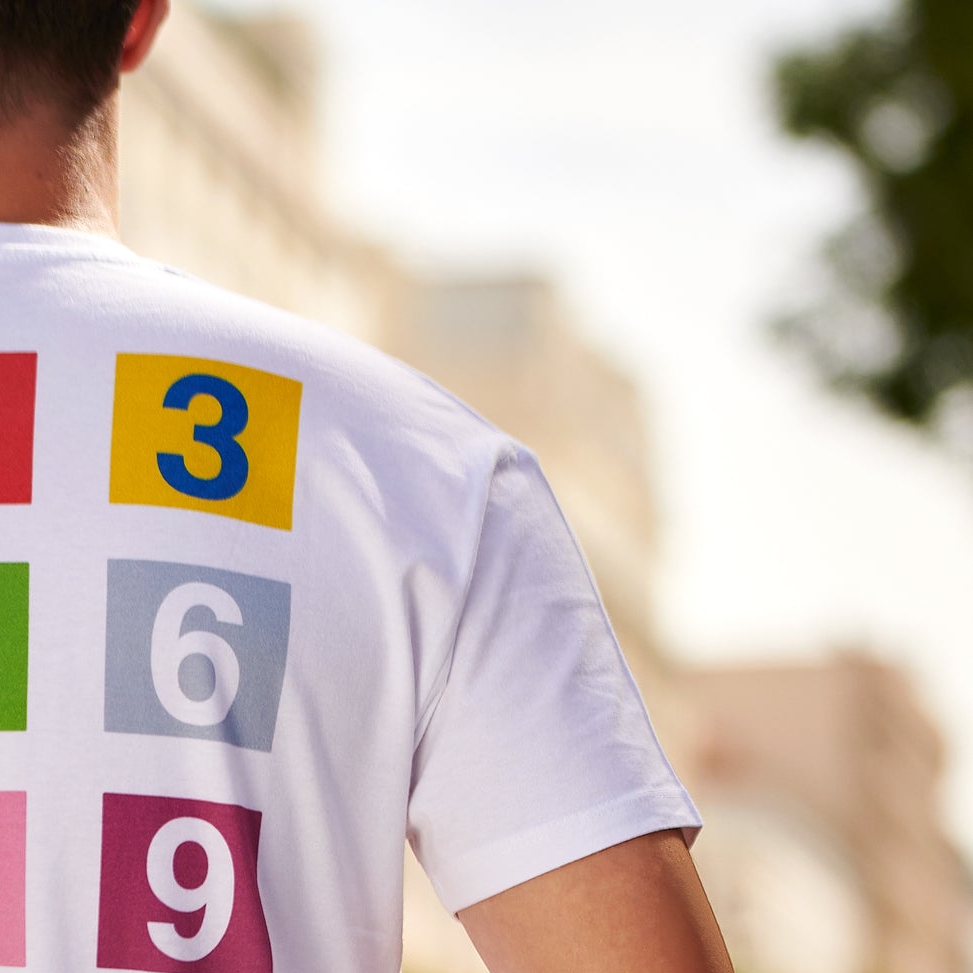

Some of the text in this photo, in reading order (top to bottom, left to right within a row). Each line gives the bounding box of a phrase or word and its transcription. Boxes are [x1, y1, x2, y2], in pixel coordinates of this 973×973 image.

[156, 374, 250, 501] 3
[149, 582, 244, 725] 6
[145, 816, 236, 962] 9
